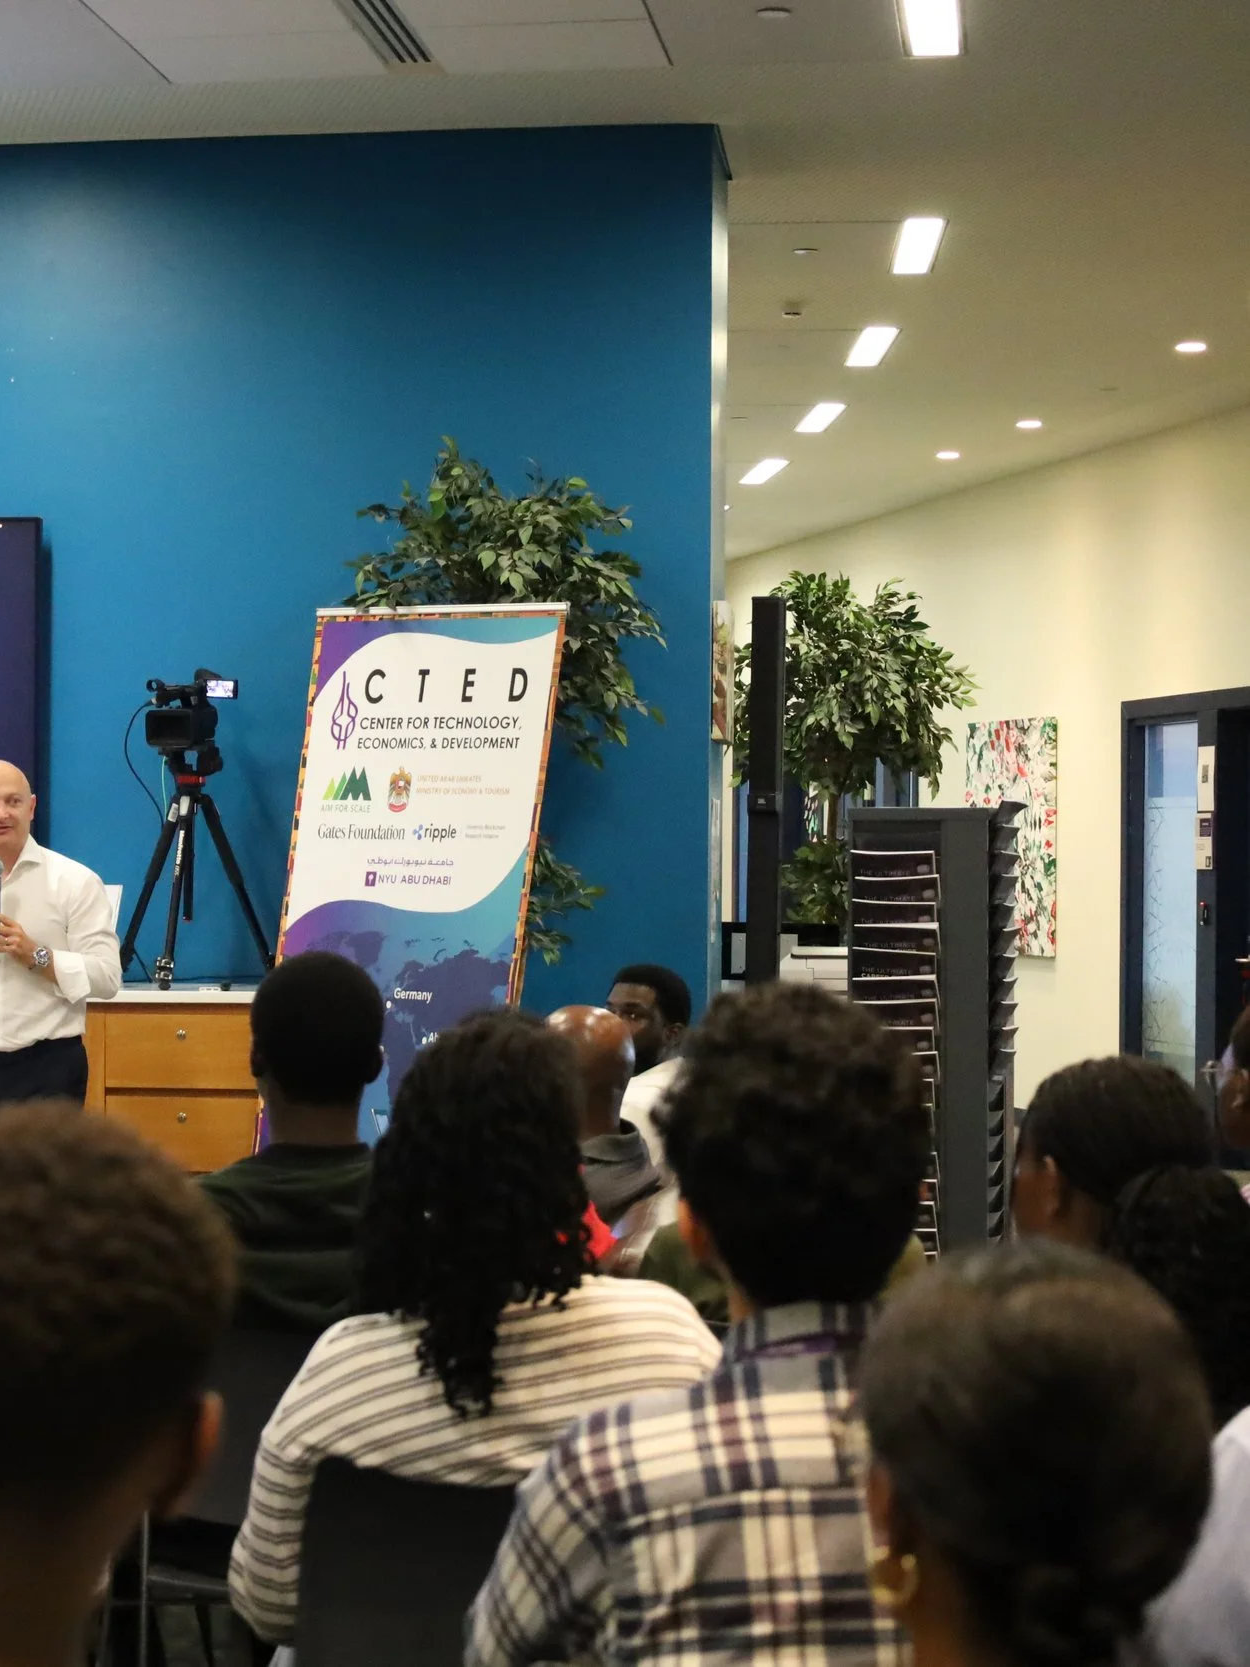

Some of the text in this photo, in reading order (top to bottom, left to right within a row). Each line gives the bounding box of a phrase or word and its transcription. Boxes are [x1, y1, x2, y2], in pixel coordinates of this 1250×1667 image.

[359, 716, 522, 731] CENTER FOR TECHNOLOGY,
[357, 737, 520, 750] ECONOMICS, & DEVELOPMENT
[335, 804, 348, 813] FOR
[350, 804, 371, 813] SCALE
[317, 824, 405, 840] Gates Foundation
[423, 823, 457, 842] ripple
[378, 873, 451, 886] NYU ABU DHABI
[393, 987, 433, 1004] Germany
